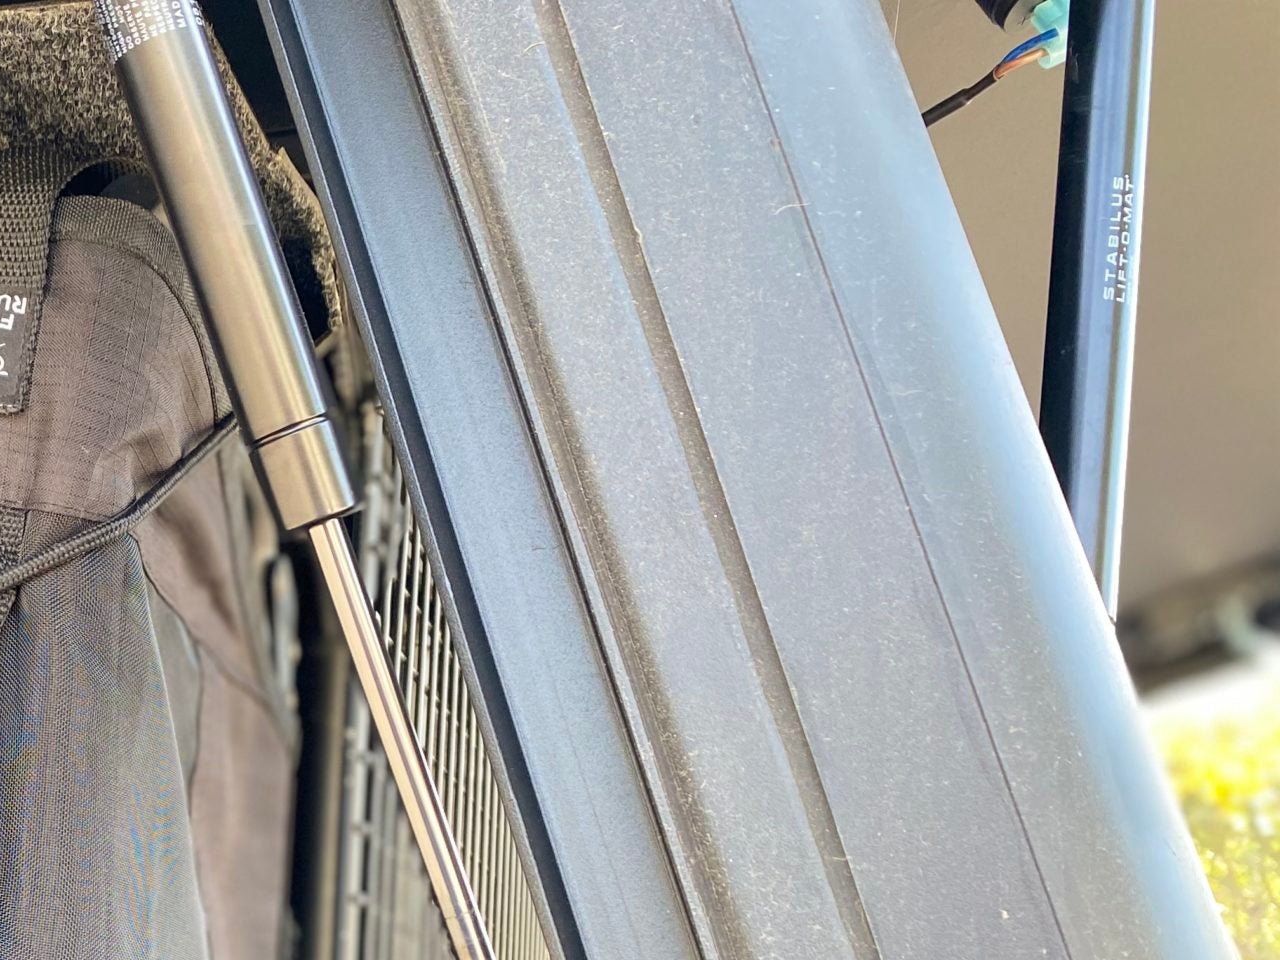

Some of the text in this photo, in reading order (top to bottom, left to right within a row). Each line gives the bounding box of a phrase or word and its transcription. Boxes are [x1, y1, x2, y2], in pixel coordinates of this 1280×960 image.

[135, 11, 150, 41] HAUTE
[125, 36, 134, 49] DO
[1103, 176, 1124, 300] STABILUS
